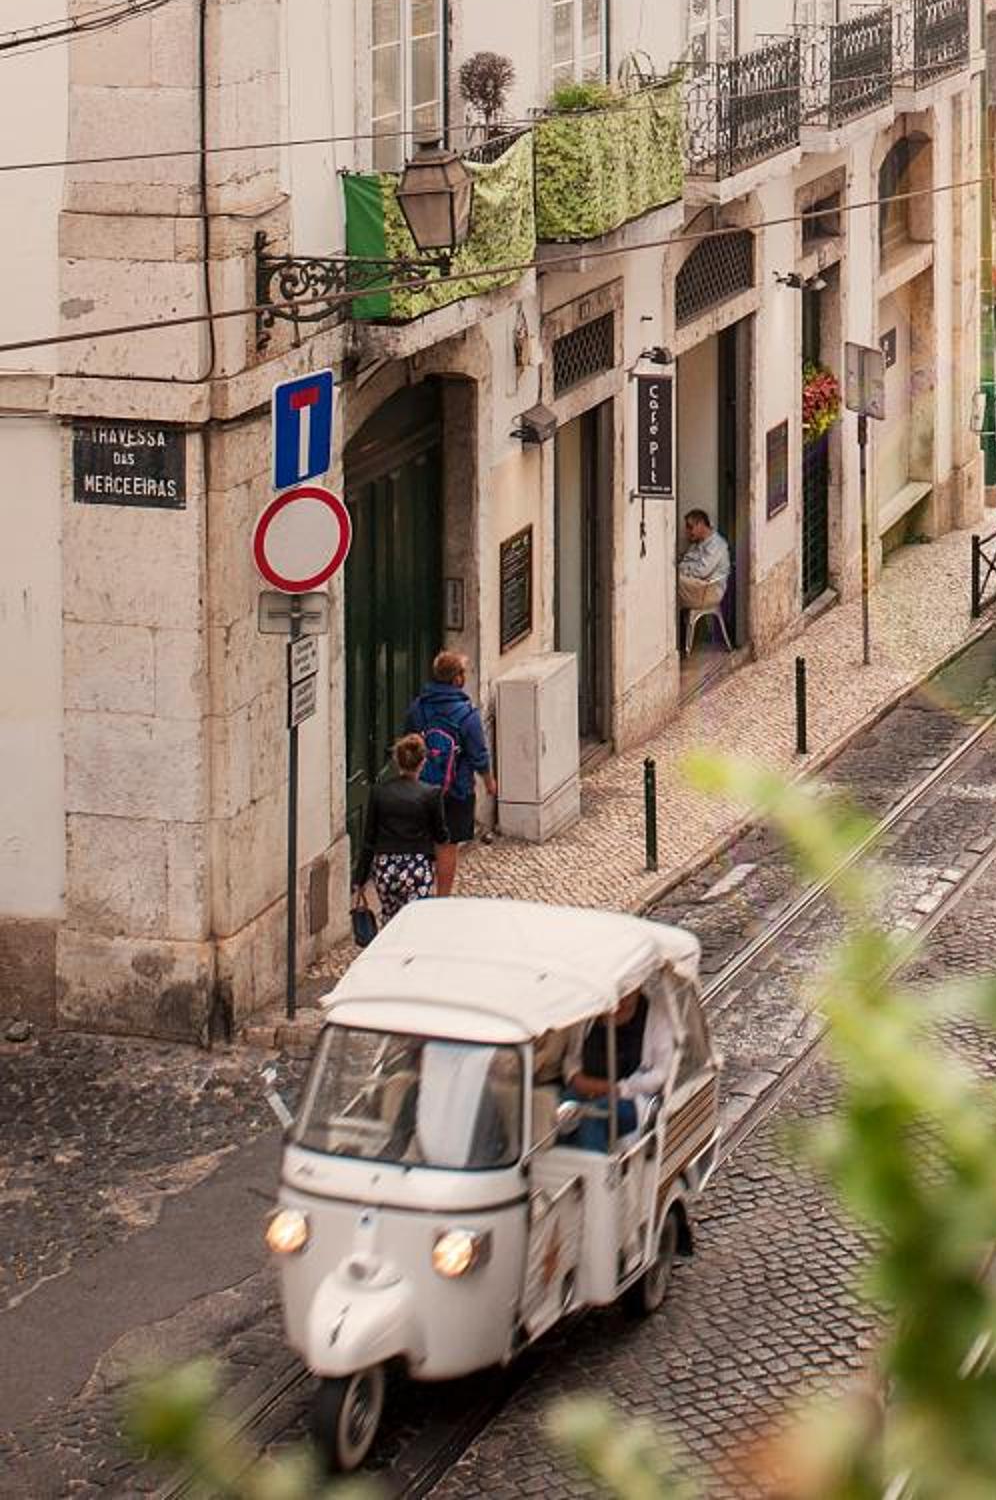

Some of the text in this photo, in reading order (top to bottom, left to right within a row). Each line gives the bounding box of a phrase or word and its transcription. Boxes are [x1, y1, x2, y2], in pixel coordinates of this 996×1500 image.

[91, 427, 166, 447] TRAVESSA
[113, 451, 135, 465] DAS
[84, 474, 177, 497] MERCEEIRAS
